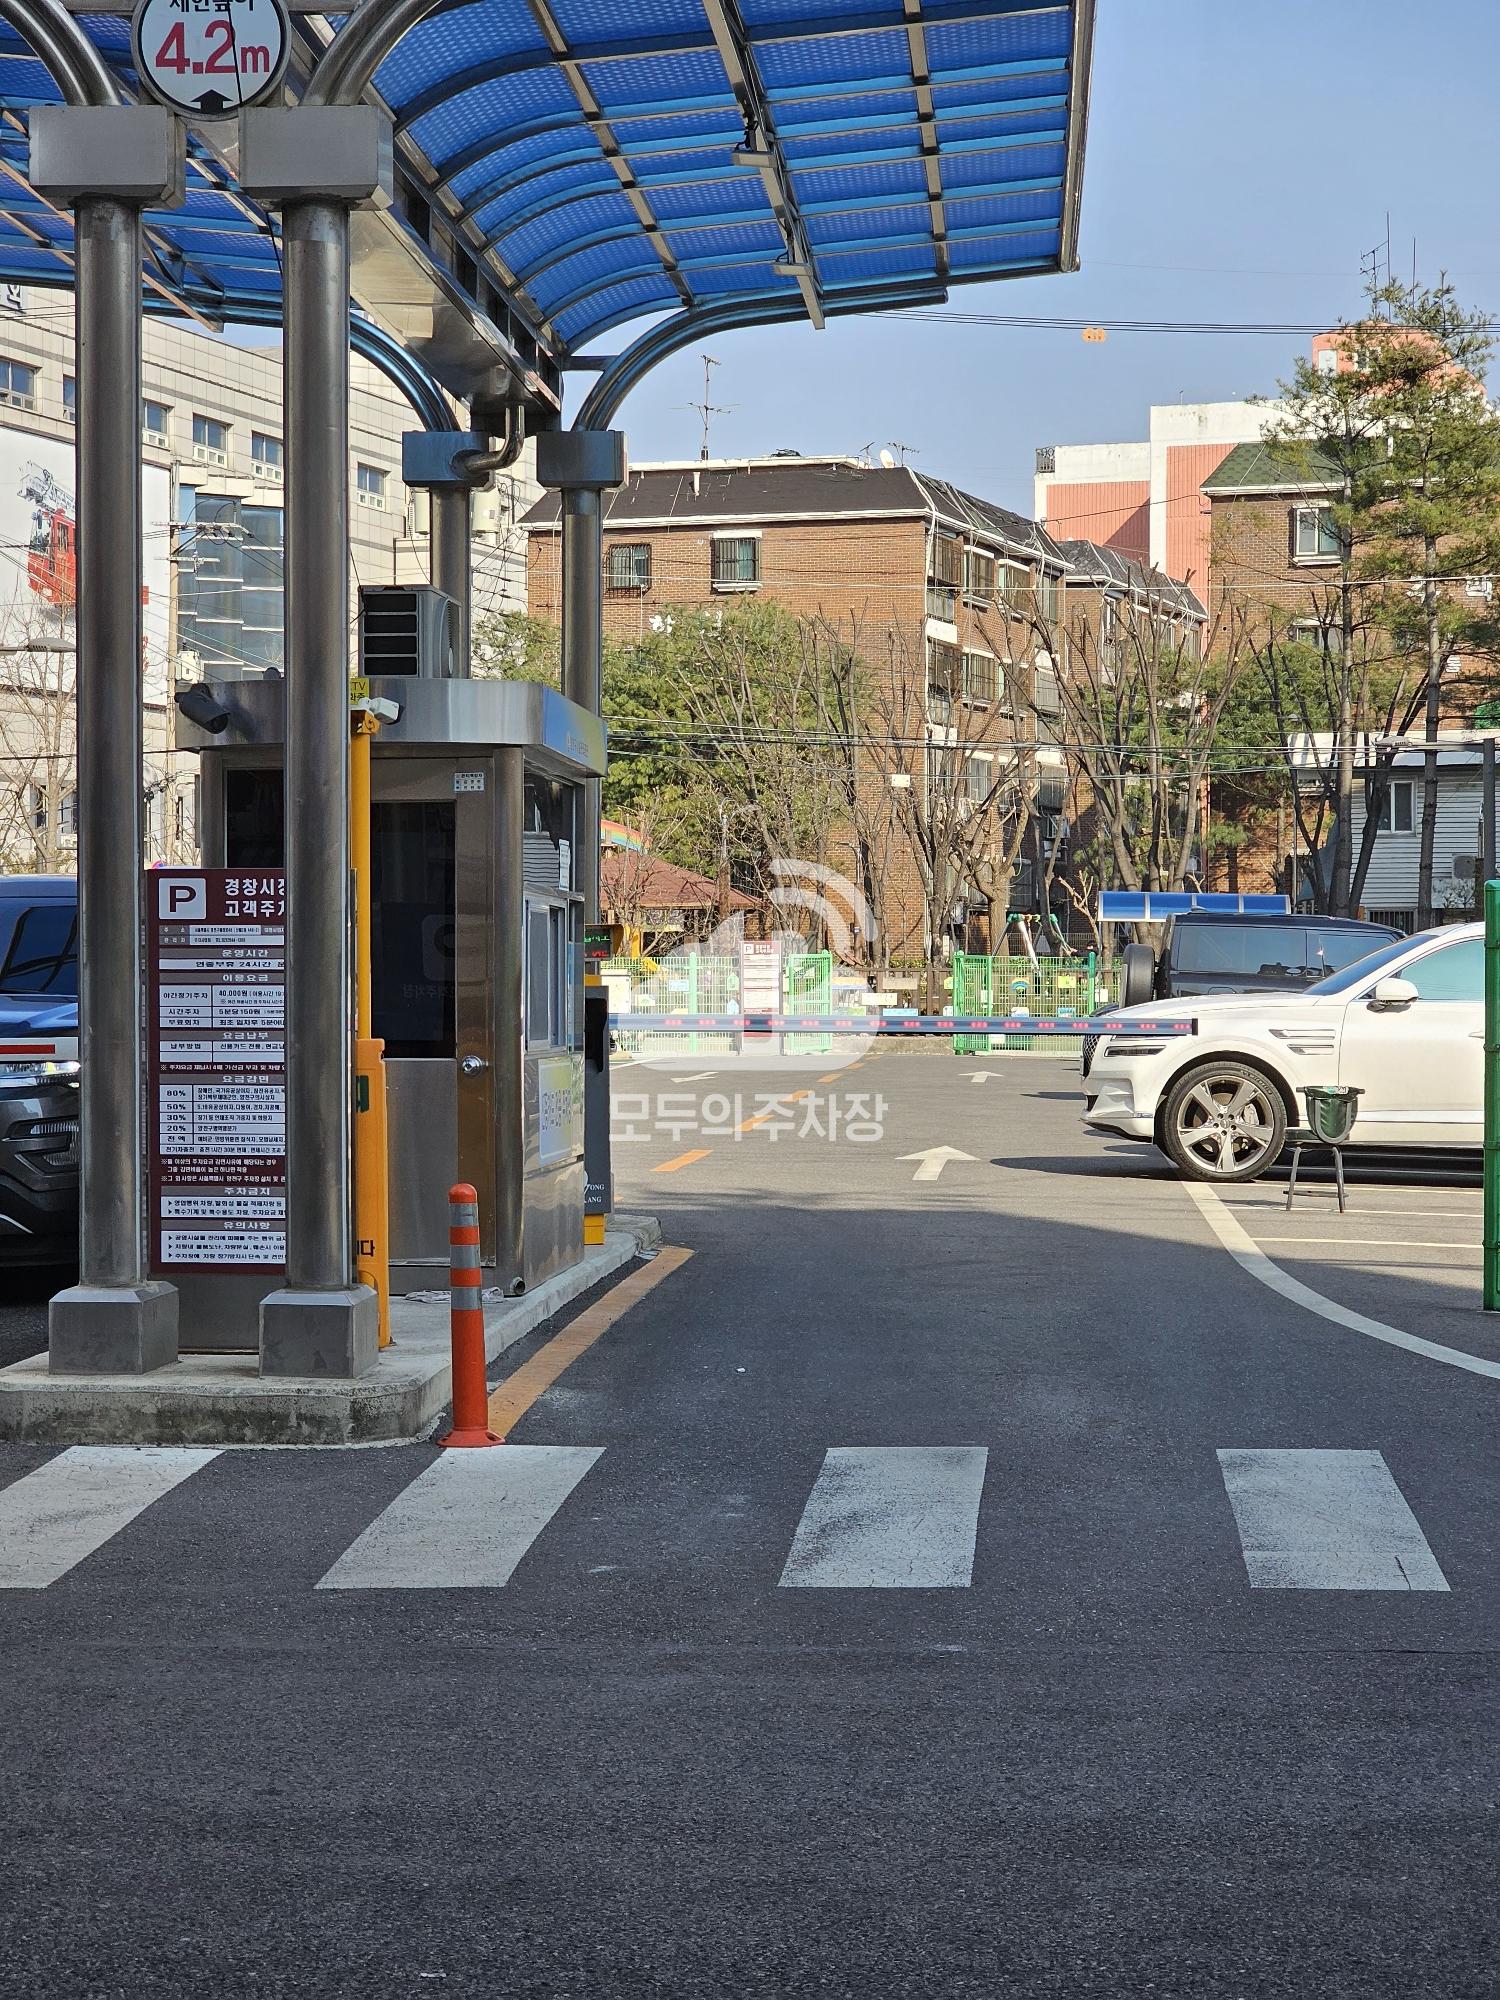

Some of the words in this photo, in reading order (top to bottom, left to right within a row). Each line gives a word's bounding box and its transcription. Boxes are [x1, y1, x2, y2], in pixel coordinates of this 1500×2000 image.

[155, 20, 269, 74] 4.2m
[170, 886, 196, 912] P
[222, 950, 268, 958] 운영시간
